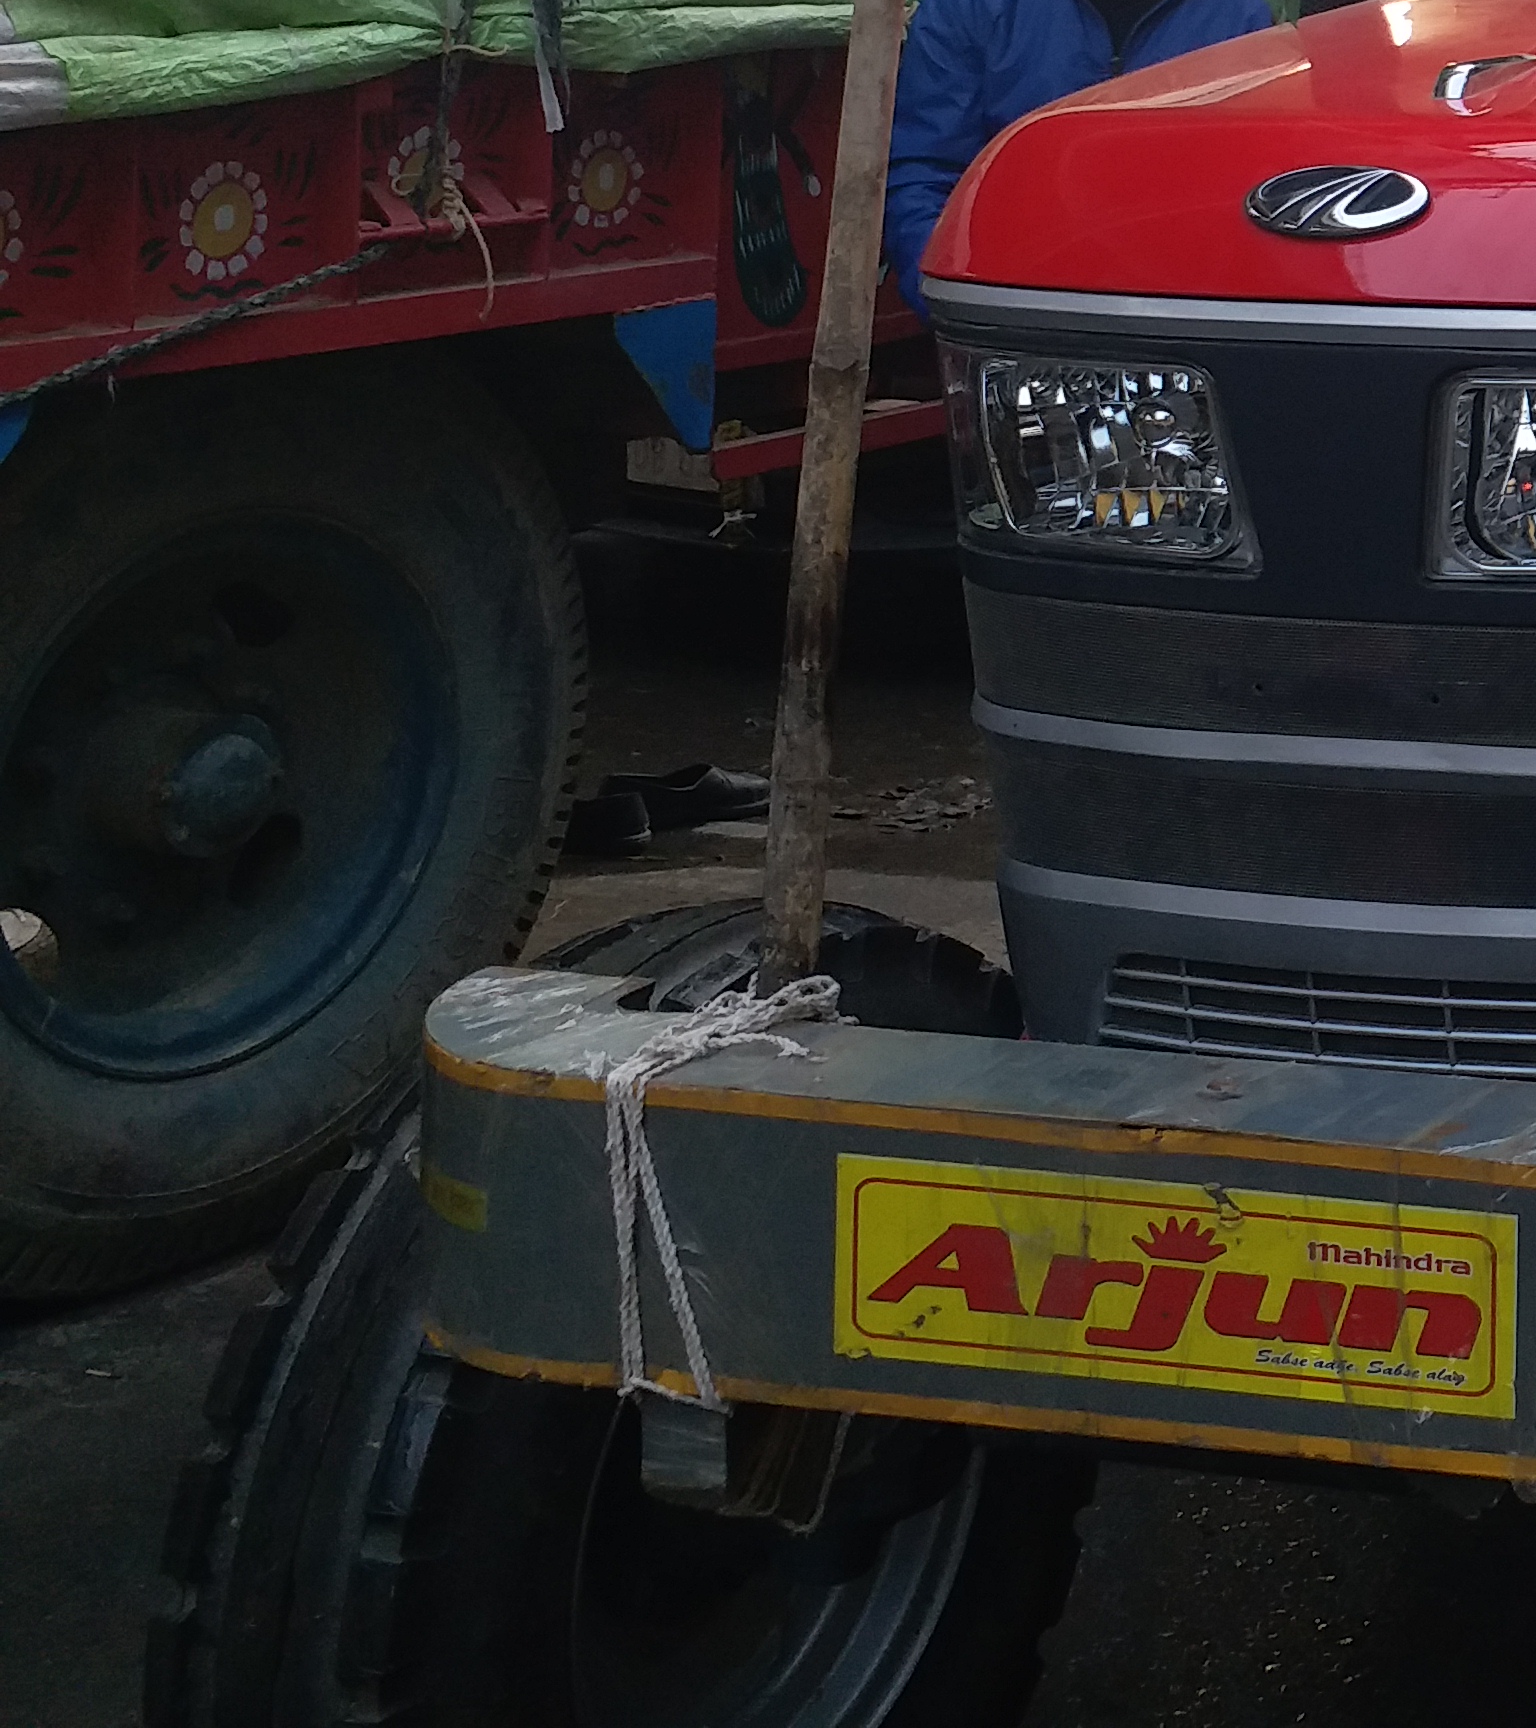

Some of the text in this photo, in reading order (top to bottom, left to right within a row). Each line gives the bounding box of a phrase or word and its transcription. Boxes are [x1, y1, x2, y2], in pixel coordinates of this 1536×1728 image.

[1308, 1240, 1473, 1278] Mahindra
[867, 1218, 1482, 1360] Arjun
[1255, 1349, 1307, 1368] Sabse
